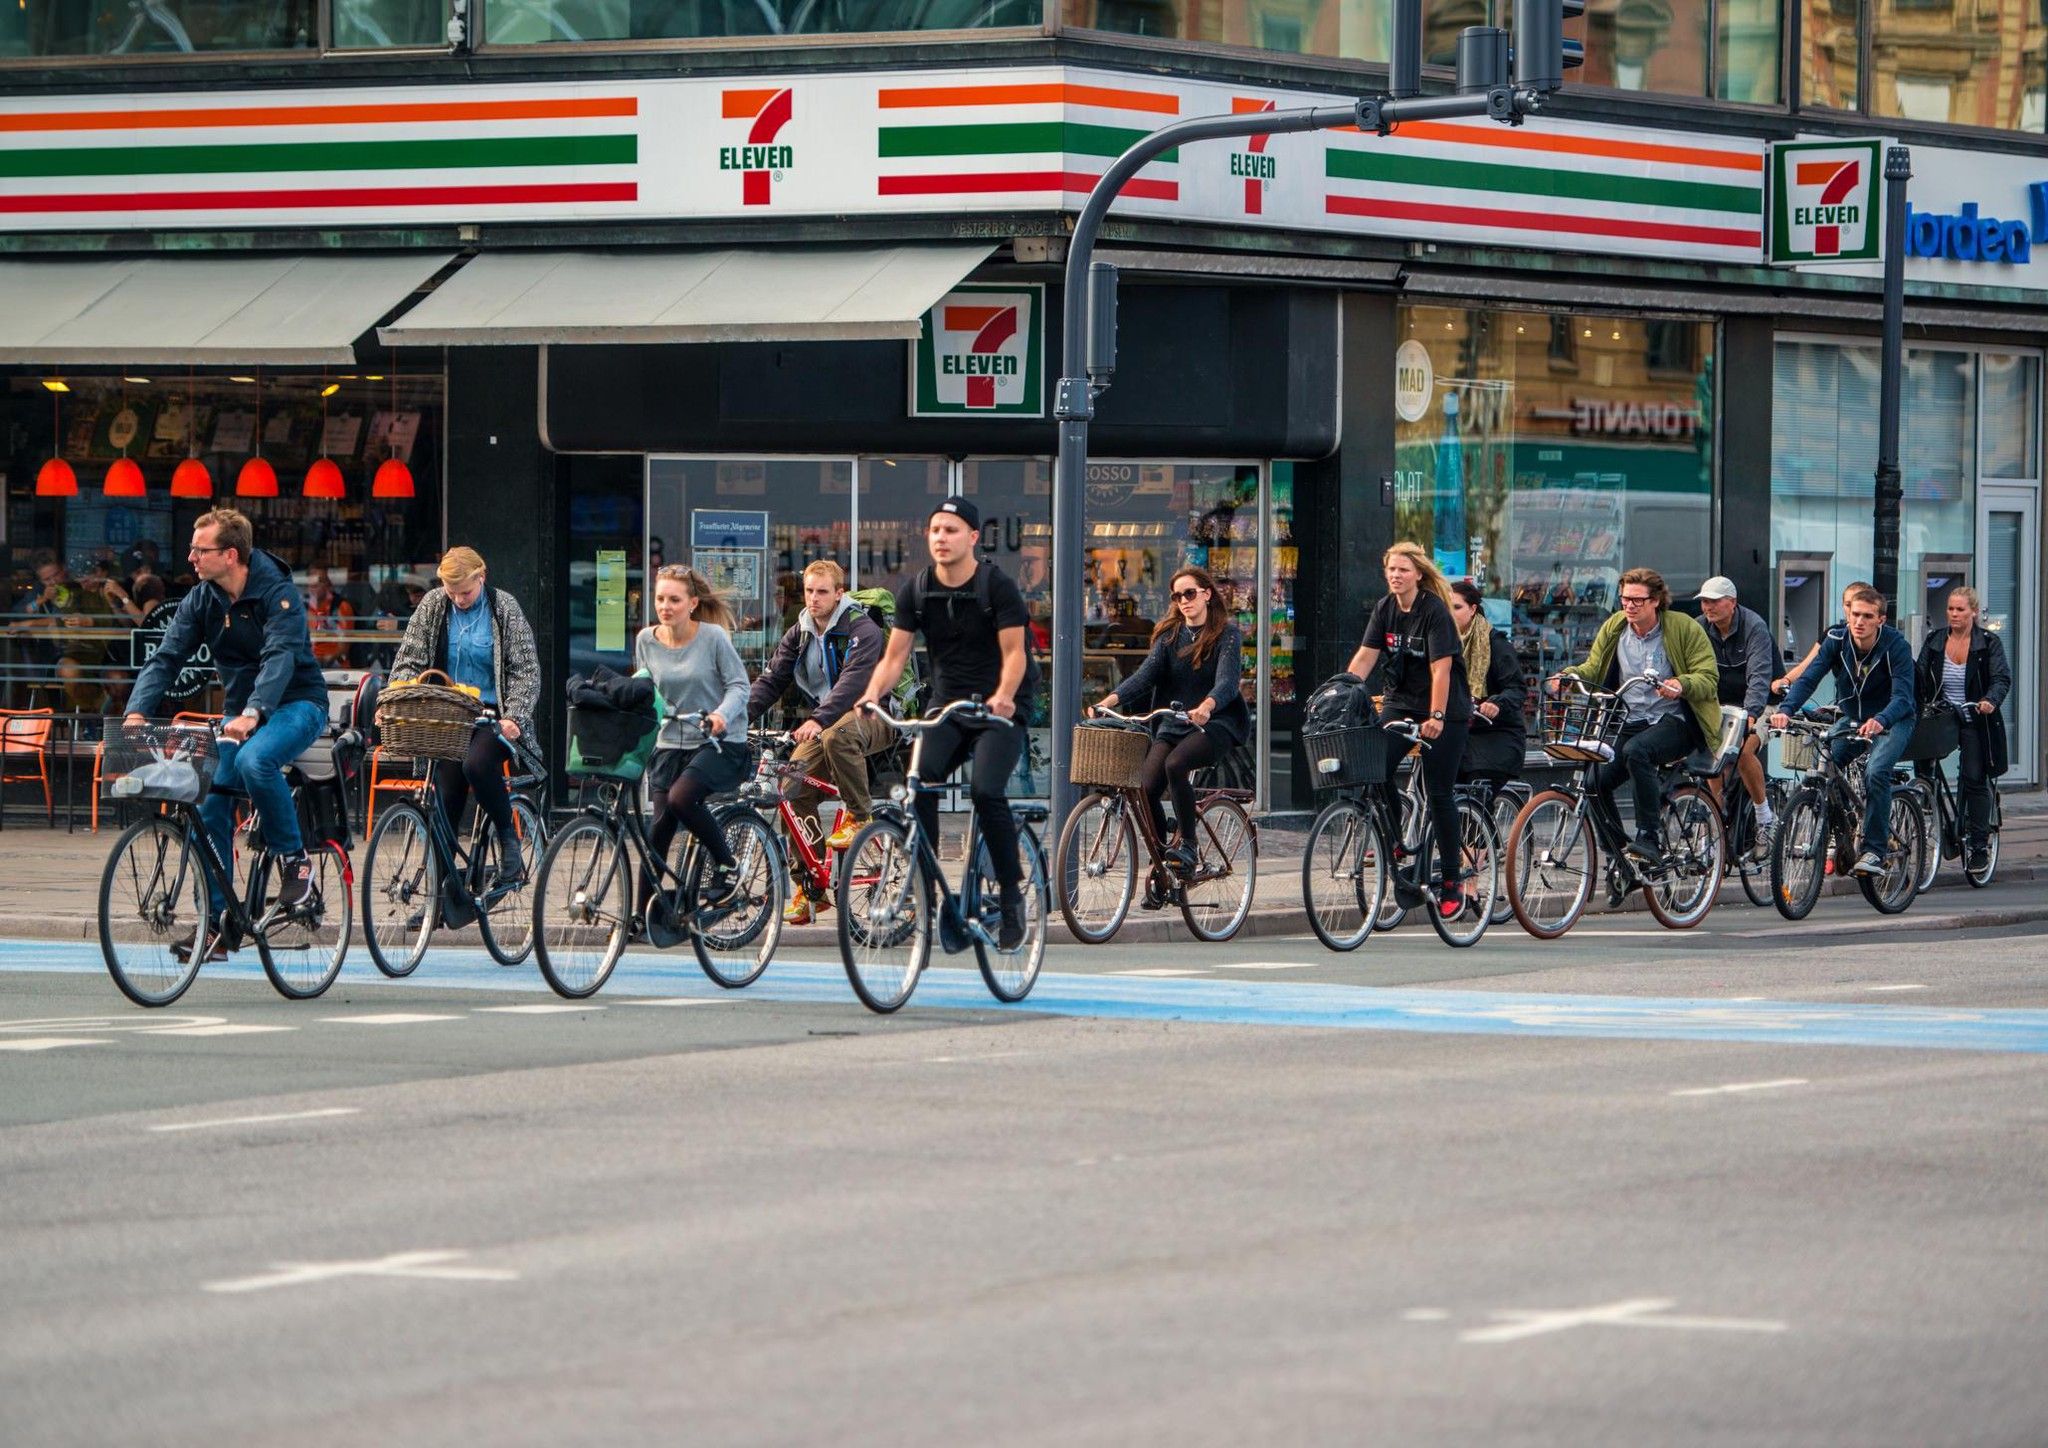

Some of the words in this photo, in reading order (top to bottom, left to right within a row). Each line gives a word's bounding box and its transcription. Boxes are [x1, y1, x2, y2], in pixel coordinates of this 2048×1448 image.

[721, 88, 792, 205] 7
[1796, 160, 1859, 254] 7
[944, 306, 1017, 407] 7
[1399, 367, 1425, 393] MAD
[1087, 465, 1131, 482] OSSO
[1394, 470, 1423, 502] ALAT
